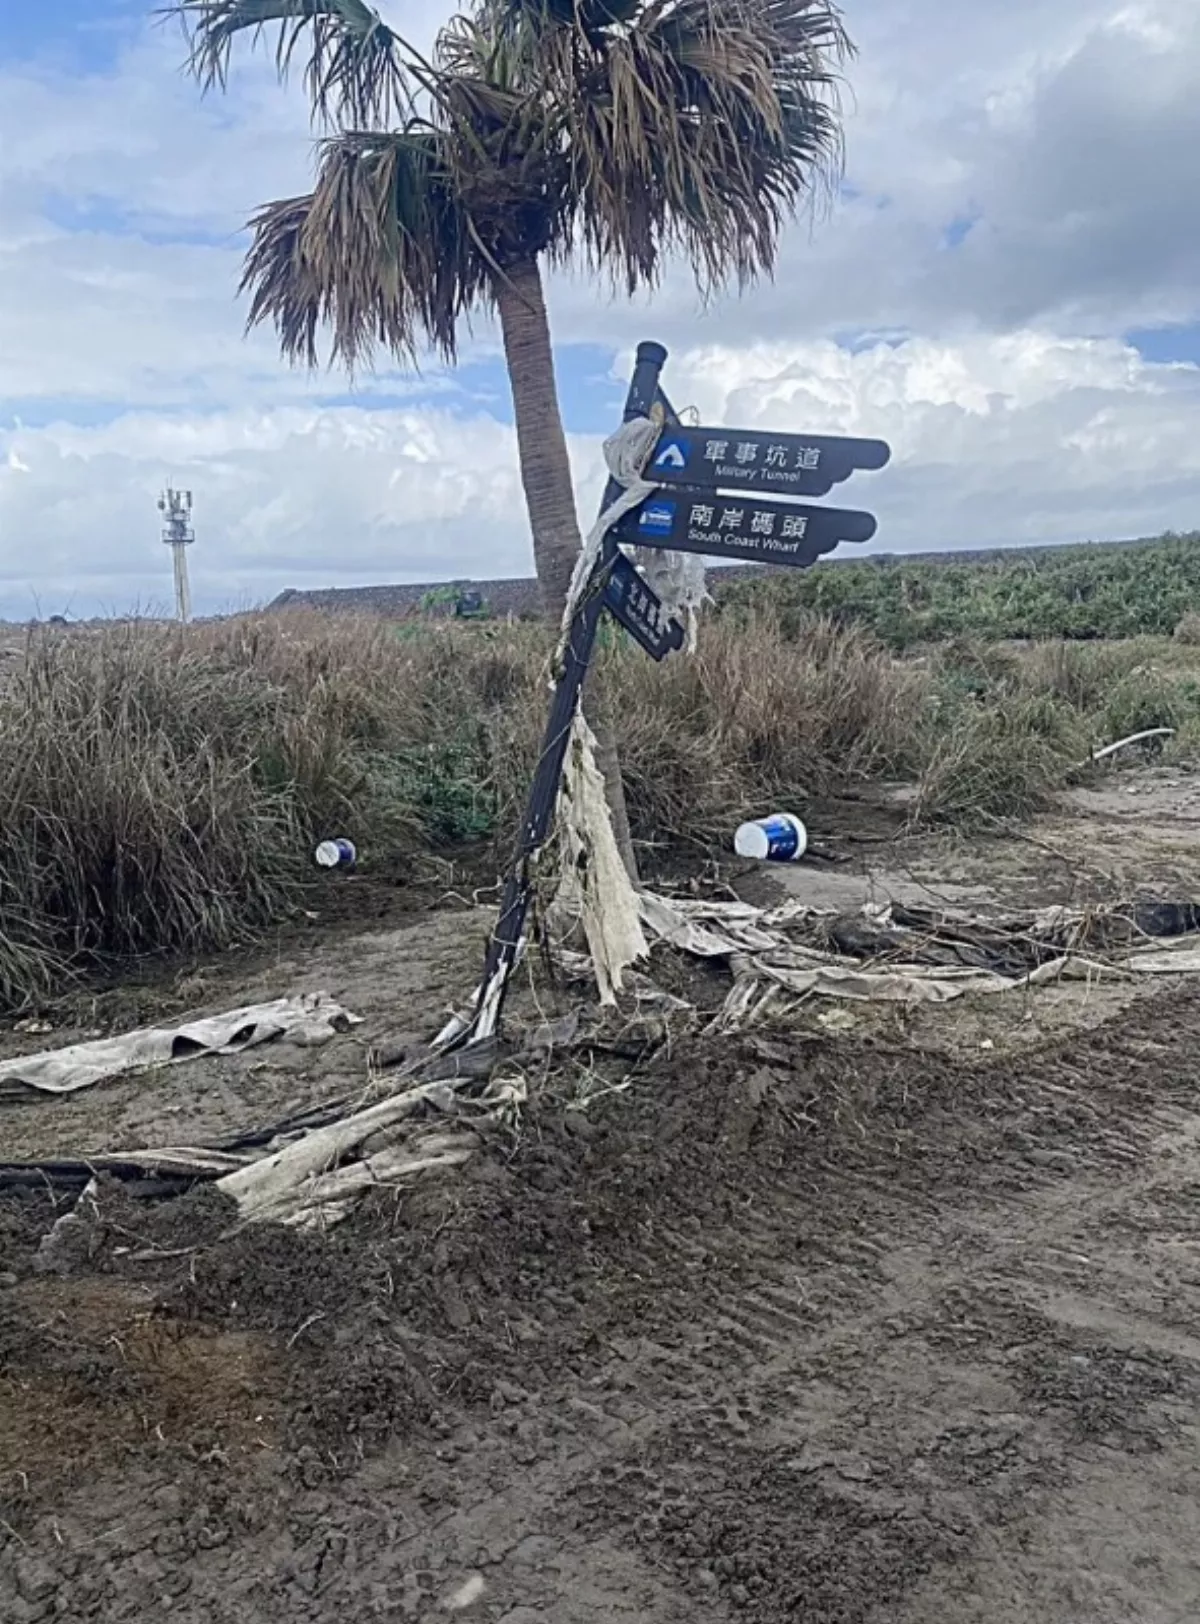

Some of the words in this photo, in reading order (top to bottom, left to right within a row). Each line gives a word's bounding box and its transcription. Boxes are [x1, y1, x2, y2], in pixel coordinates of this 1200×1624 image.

[704, 440, 821, 470] 軍事坑道
[715, 465, 757, 480] Military
[760, 468, 800, 482] Tunnel
[689, 504, 808, 539] 南岸碼頭
[688, 529, 721, 543] South
[724, 534, 760, 549] Coast
[762, 538, 799, 553] Wharf
